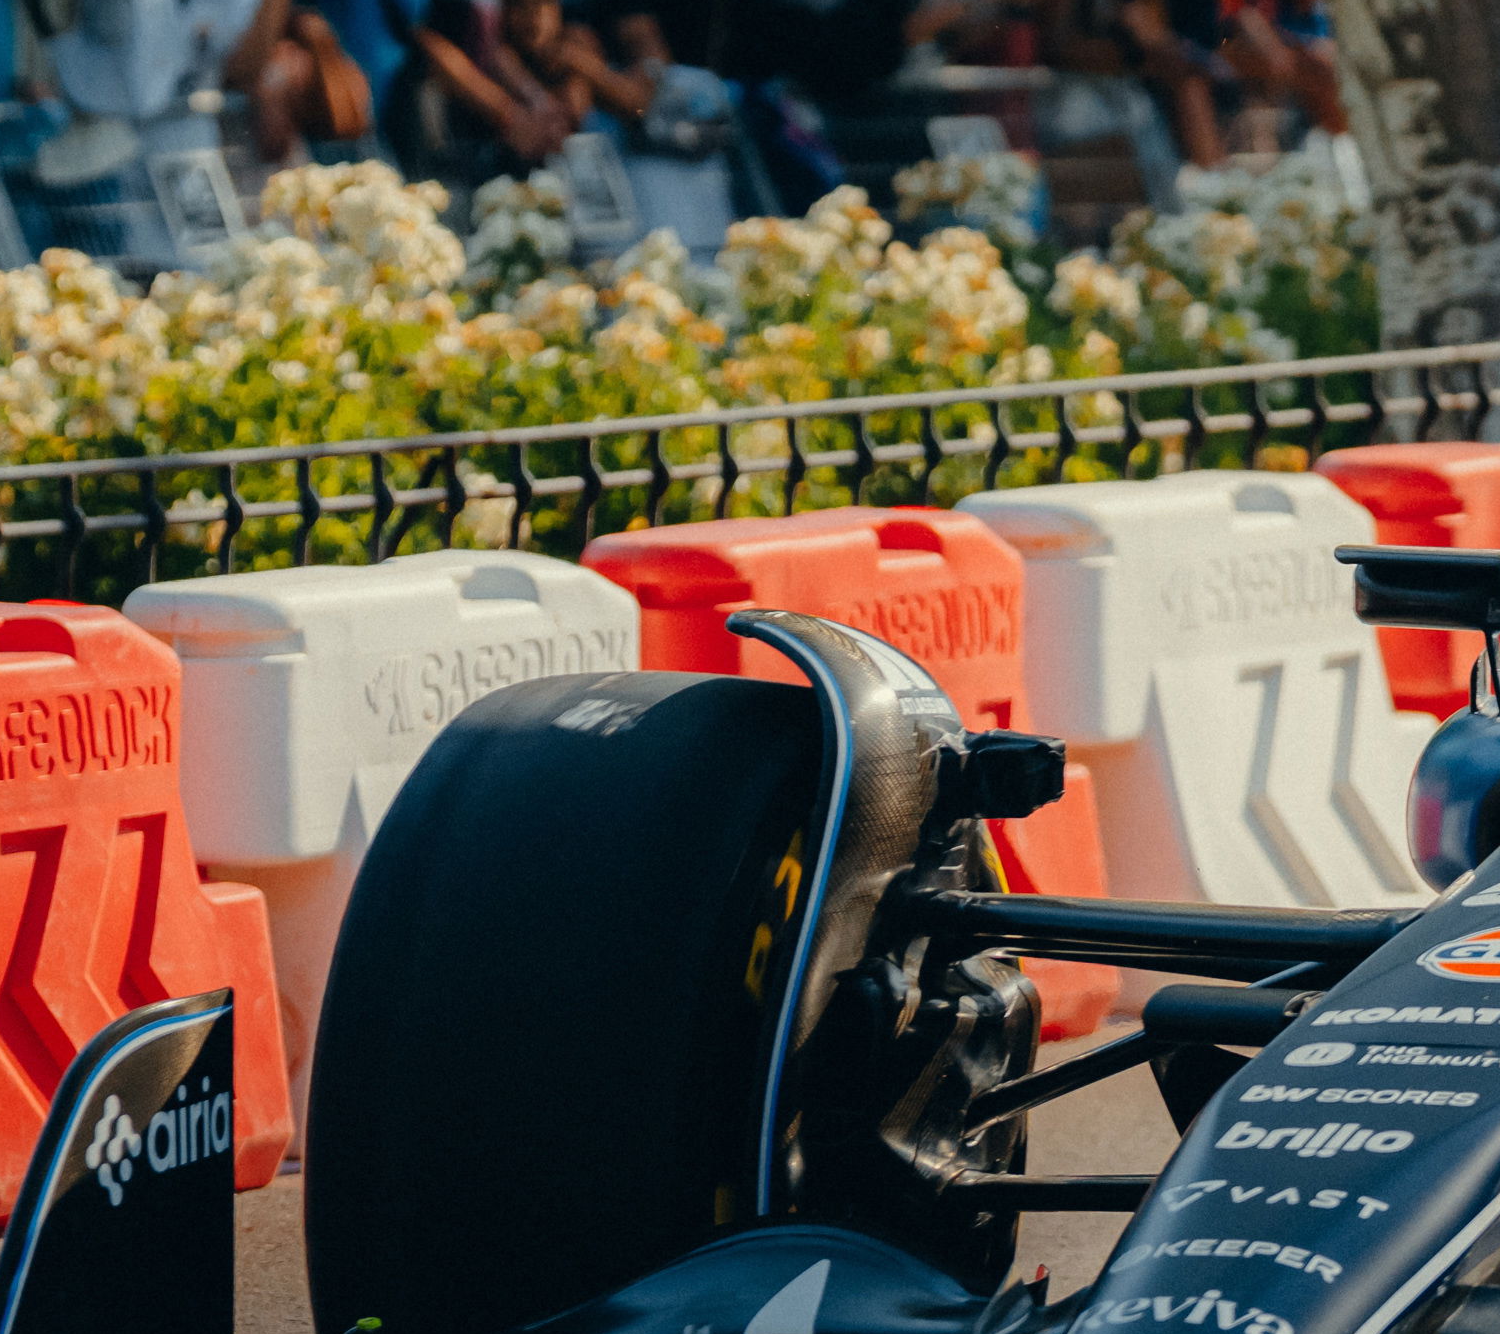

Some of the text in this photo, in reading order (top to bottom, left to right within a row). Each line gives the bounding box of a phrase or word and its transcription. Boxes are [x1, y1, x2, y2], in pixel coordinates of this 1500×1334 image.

[1239, 1084, 1481, 1108] bw SCORES
[146, 1074, 231, 1174] airia
[1214, 1120, 1415, 1158] brillio
[1229, 1184, 1390, 1221] VAST
[1152, 1238, 1344, 1284] KEEPER
